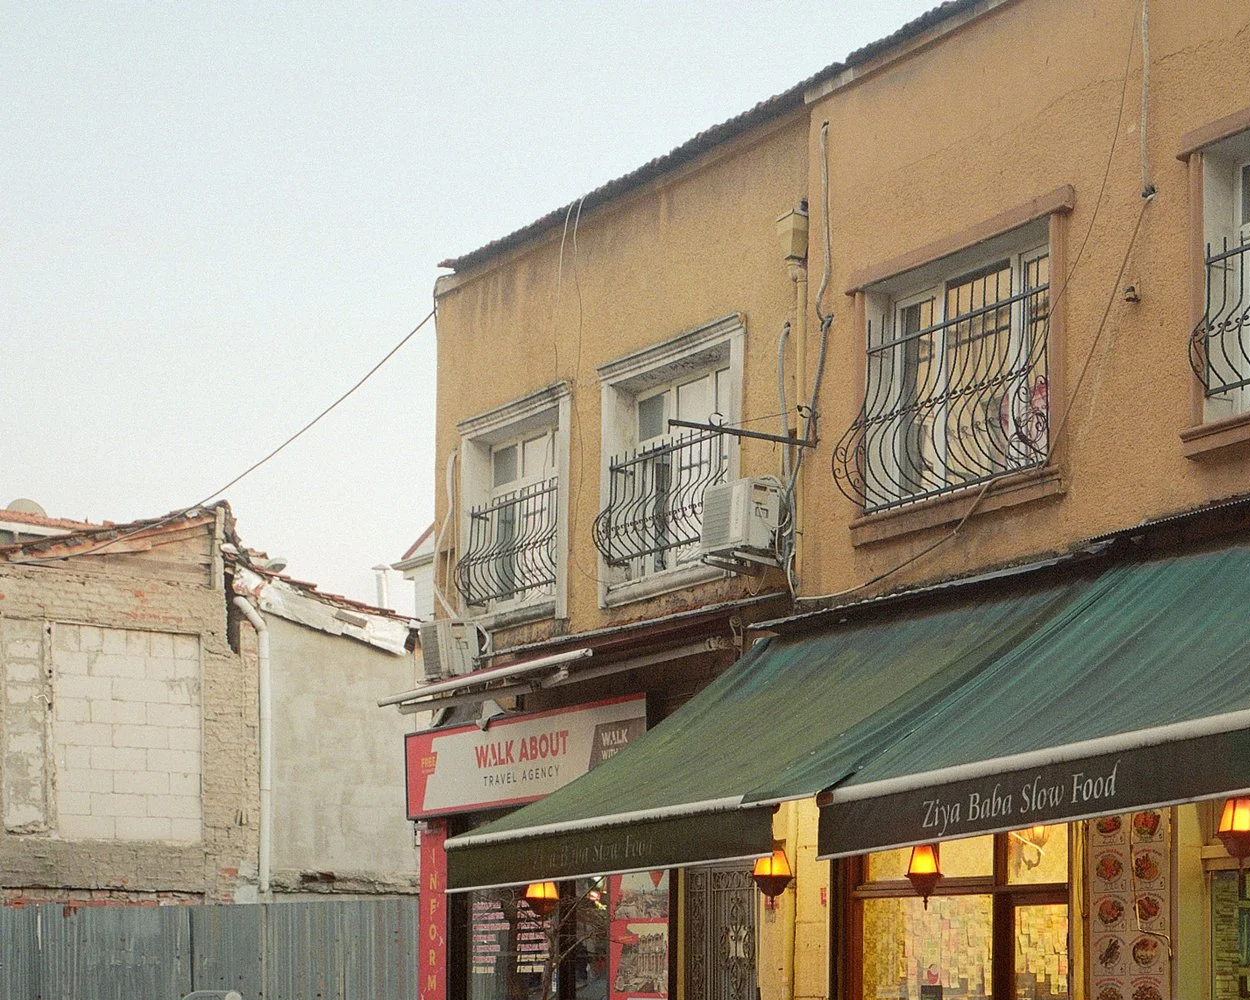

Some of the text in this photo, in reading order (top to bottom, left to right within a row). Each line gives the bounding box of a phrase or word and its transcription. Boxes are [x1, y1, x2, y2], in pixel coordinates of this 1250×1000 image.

[475, 730, 569, 769] WALK ABOUT
[601, 728, 629, 747] WALK
[484, 765, 560, 787] TRAVEL AGENCY
[922, 760, 1122, 836] Ziya Baba Slow Food
